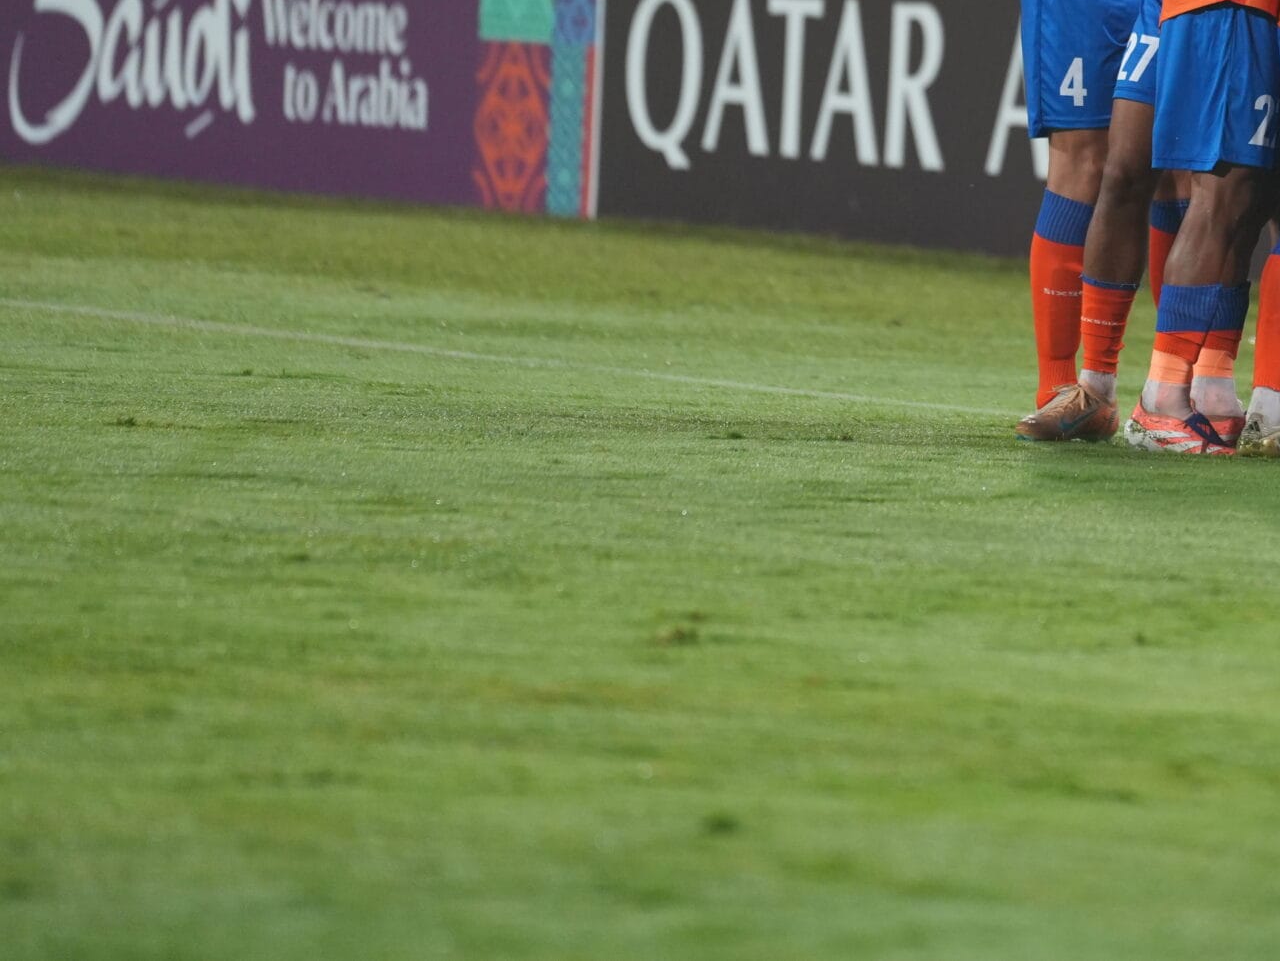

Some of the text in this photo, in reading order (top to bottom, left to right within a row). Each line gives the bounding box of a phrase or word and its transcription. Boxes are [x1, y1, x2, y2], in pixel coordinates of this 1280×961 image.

[1059, 57, 1088, 107] 4
[1117, 32, 1160, 82] 27
[283, 56, 428, 130] to Arabia
